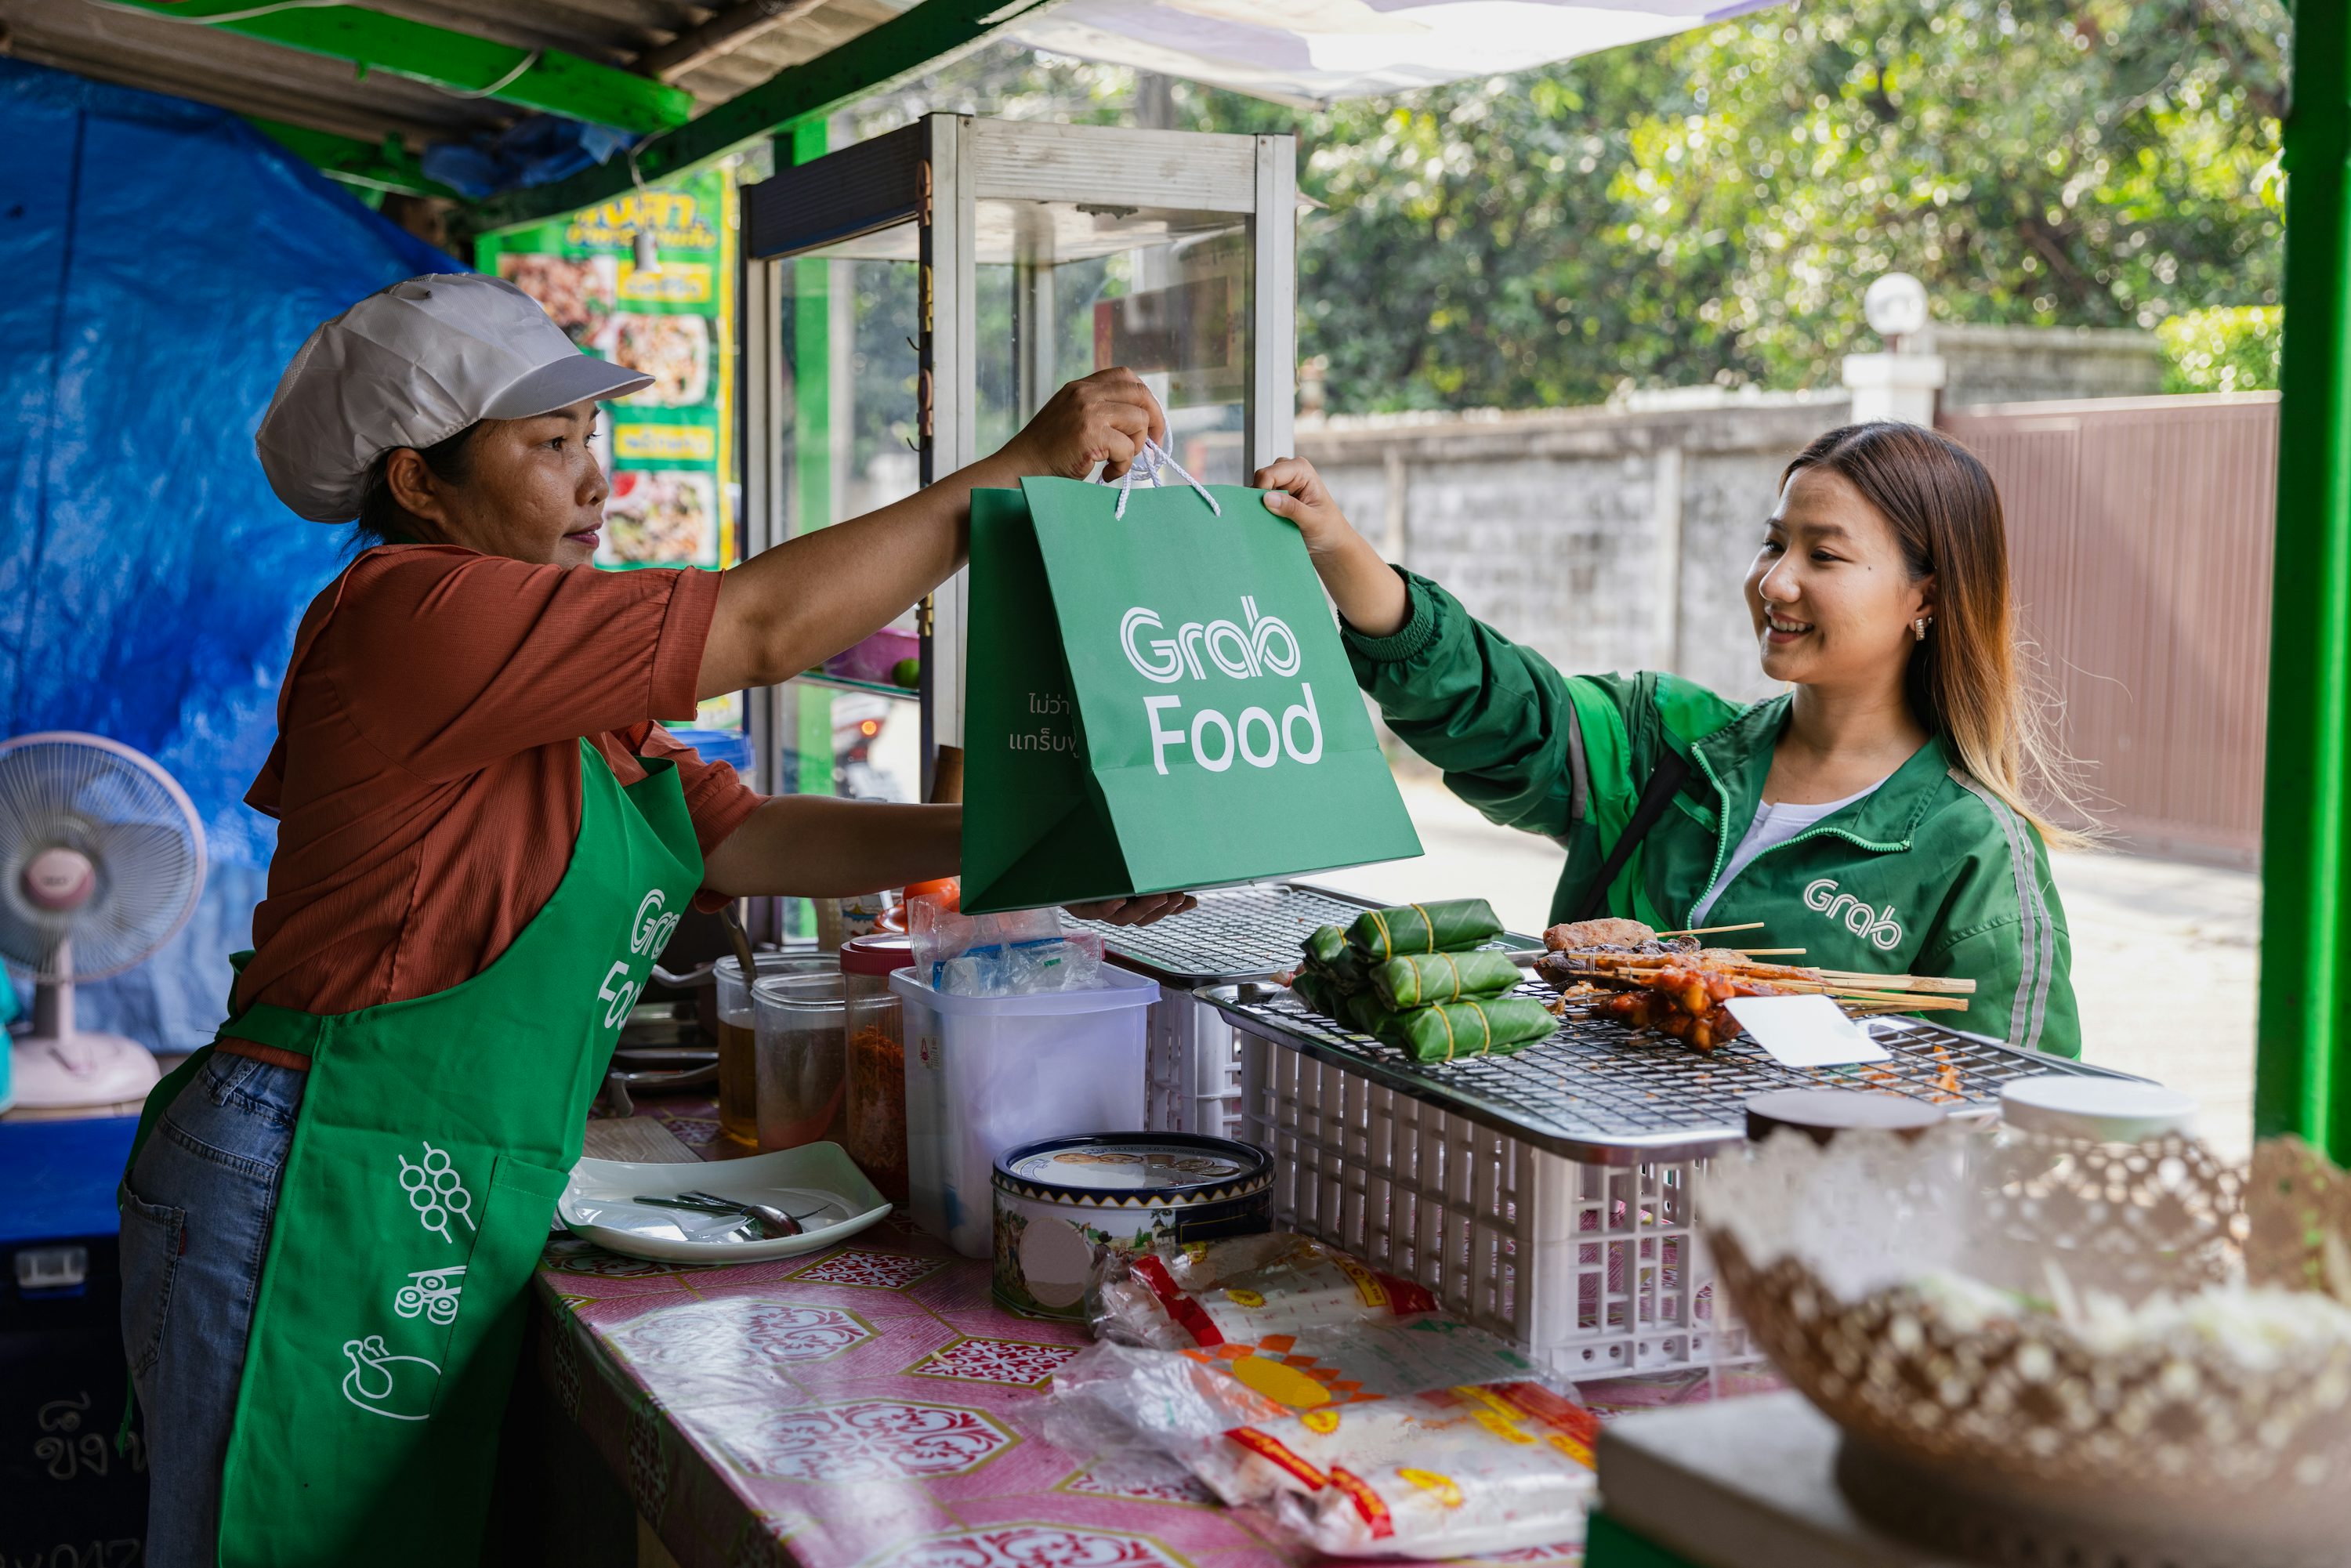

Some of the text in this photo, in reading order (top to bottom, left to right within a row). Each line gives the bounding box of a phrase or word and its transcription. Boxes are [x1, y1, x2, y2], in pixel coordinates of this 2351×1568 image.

[1120, 595, 1301, 683] Grab
[1028, 692, 1070, 715] ไม่ว่า
[1143, 682, 1324, 775] Food
[630, 888, 681, 960] Gra
[1803, 878, 1903, 951] Grab
[596, 960, 646, 1031] Foo
